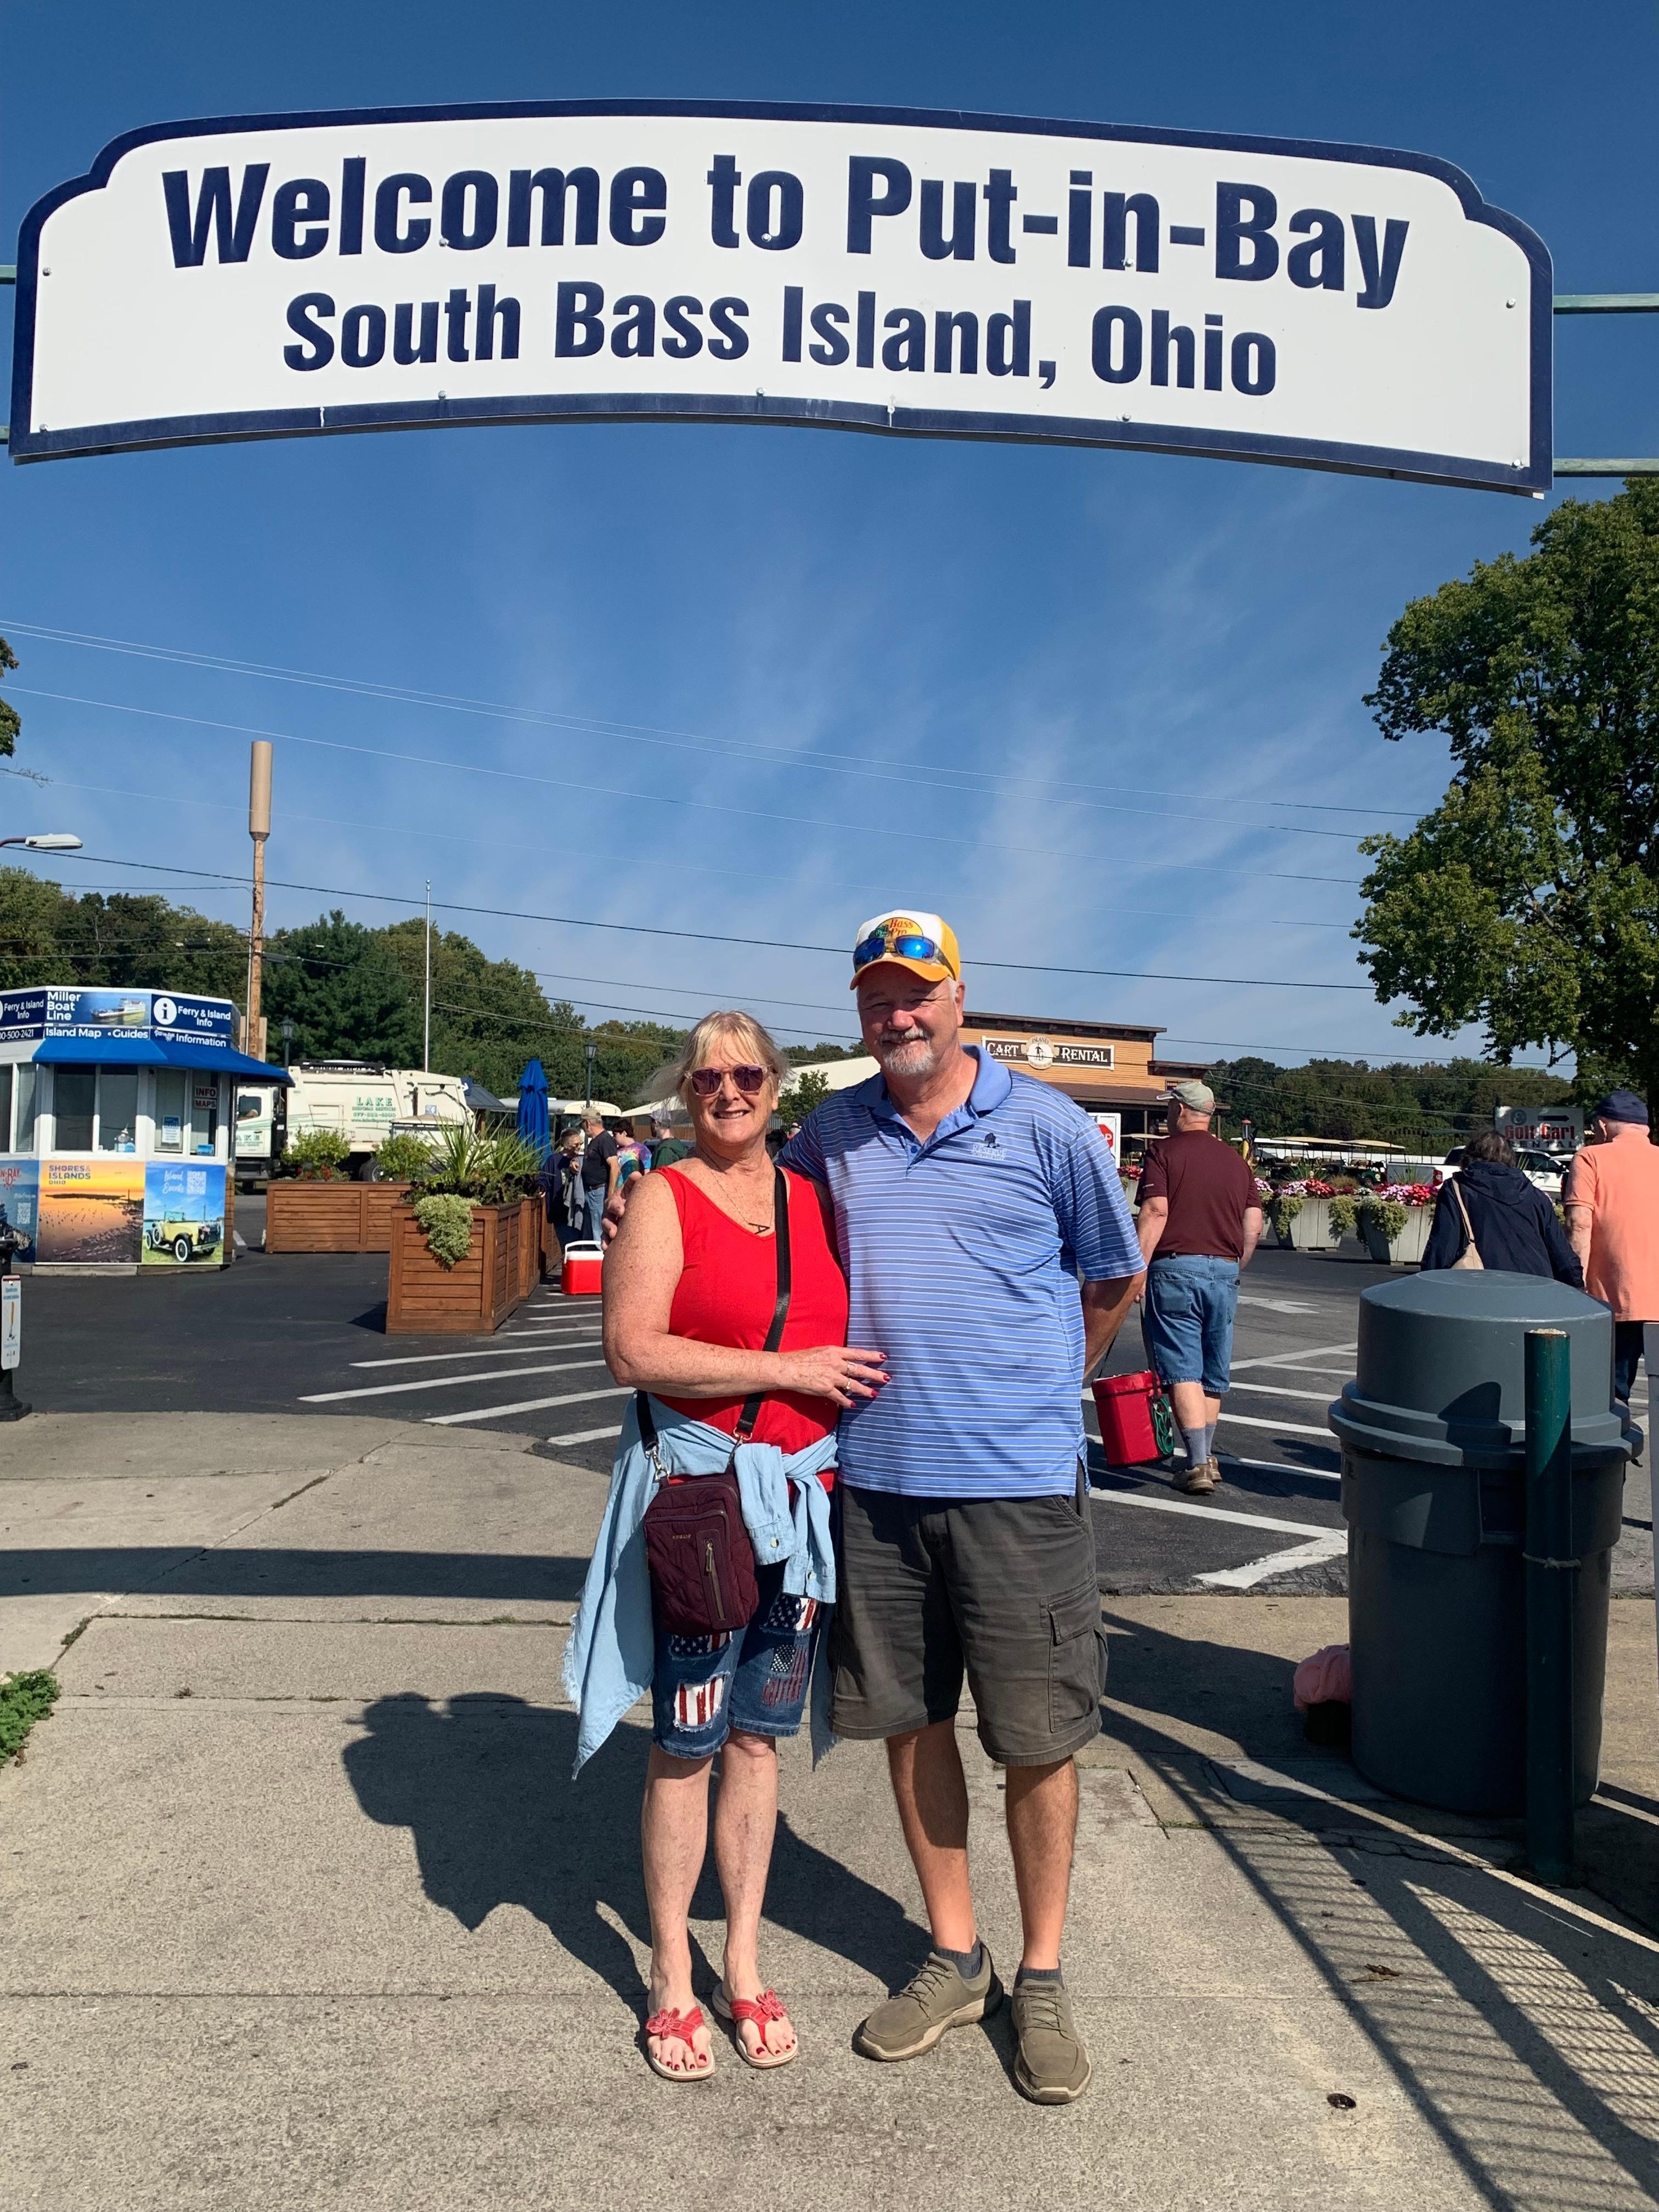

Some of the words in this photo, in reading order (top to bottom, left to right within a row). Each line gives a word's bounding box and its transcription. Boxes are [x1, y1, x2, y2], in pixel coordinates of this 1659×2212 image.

[162, 156, 667, 268] Welcome
[707, 155, 803, 250] to
[847, 156, 1409, 309] Put-in-Bay
[284, 284, 520, 371] South
[555, 281, 749, 360] Bass
[782, 286, 1056, 389] Island,
[1092, 306, 1276, 396] Ohio
[890, 919, 913, 928] Bass
[48, 991, 81, 1002] Miller
[4, 1003, 20, 1012] Ferry
[20, 1002, 25, 1010] &
[26, 999, 44, 1009] Island
[47, 1001, 75, 1011] Boat
[17, 1010, 30, 1019] Info
[47, 1011, 71, 1020] Line
[178, 1006, 199, 1018] Ferry
[207, 1010, 231, 1020] Island
[196, 1018, 213, 1027] Info
[46, 1028, 76, 1036] Island
[78, 1028, 101, 1039] Map
[112, 1029, 148, 1039] Guides
[176, 1034, 227, 1047] Information
[987, 1042, 1019, 1057] CART
[1061, 1047, 1108, 1063] RENTAL
[196, 1088, 216, 1097] INFO
[357, 1097, 392, 1106] LAKE
[1541, 1124, 1575, 1139] Cart
